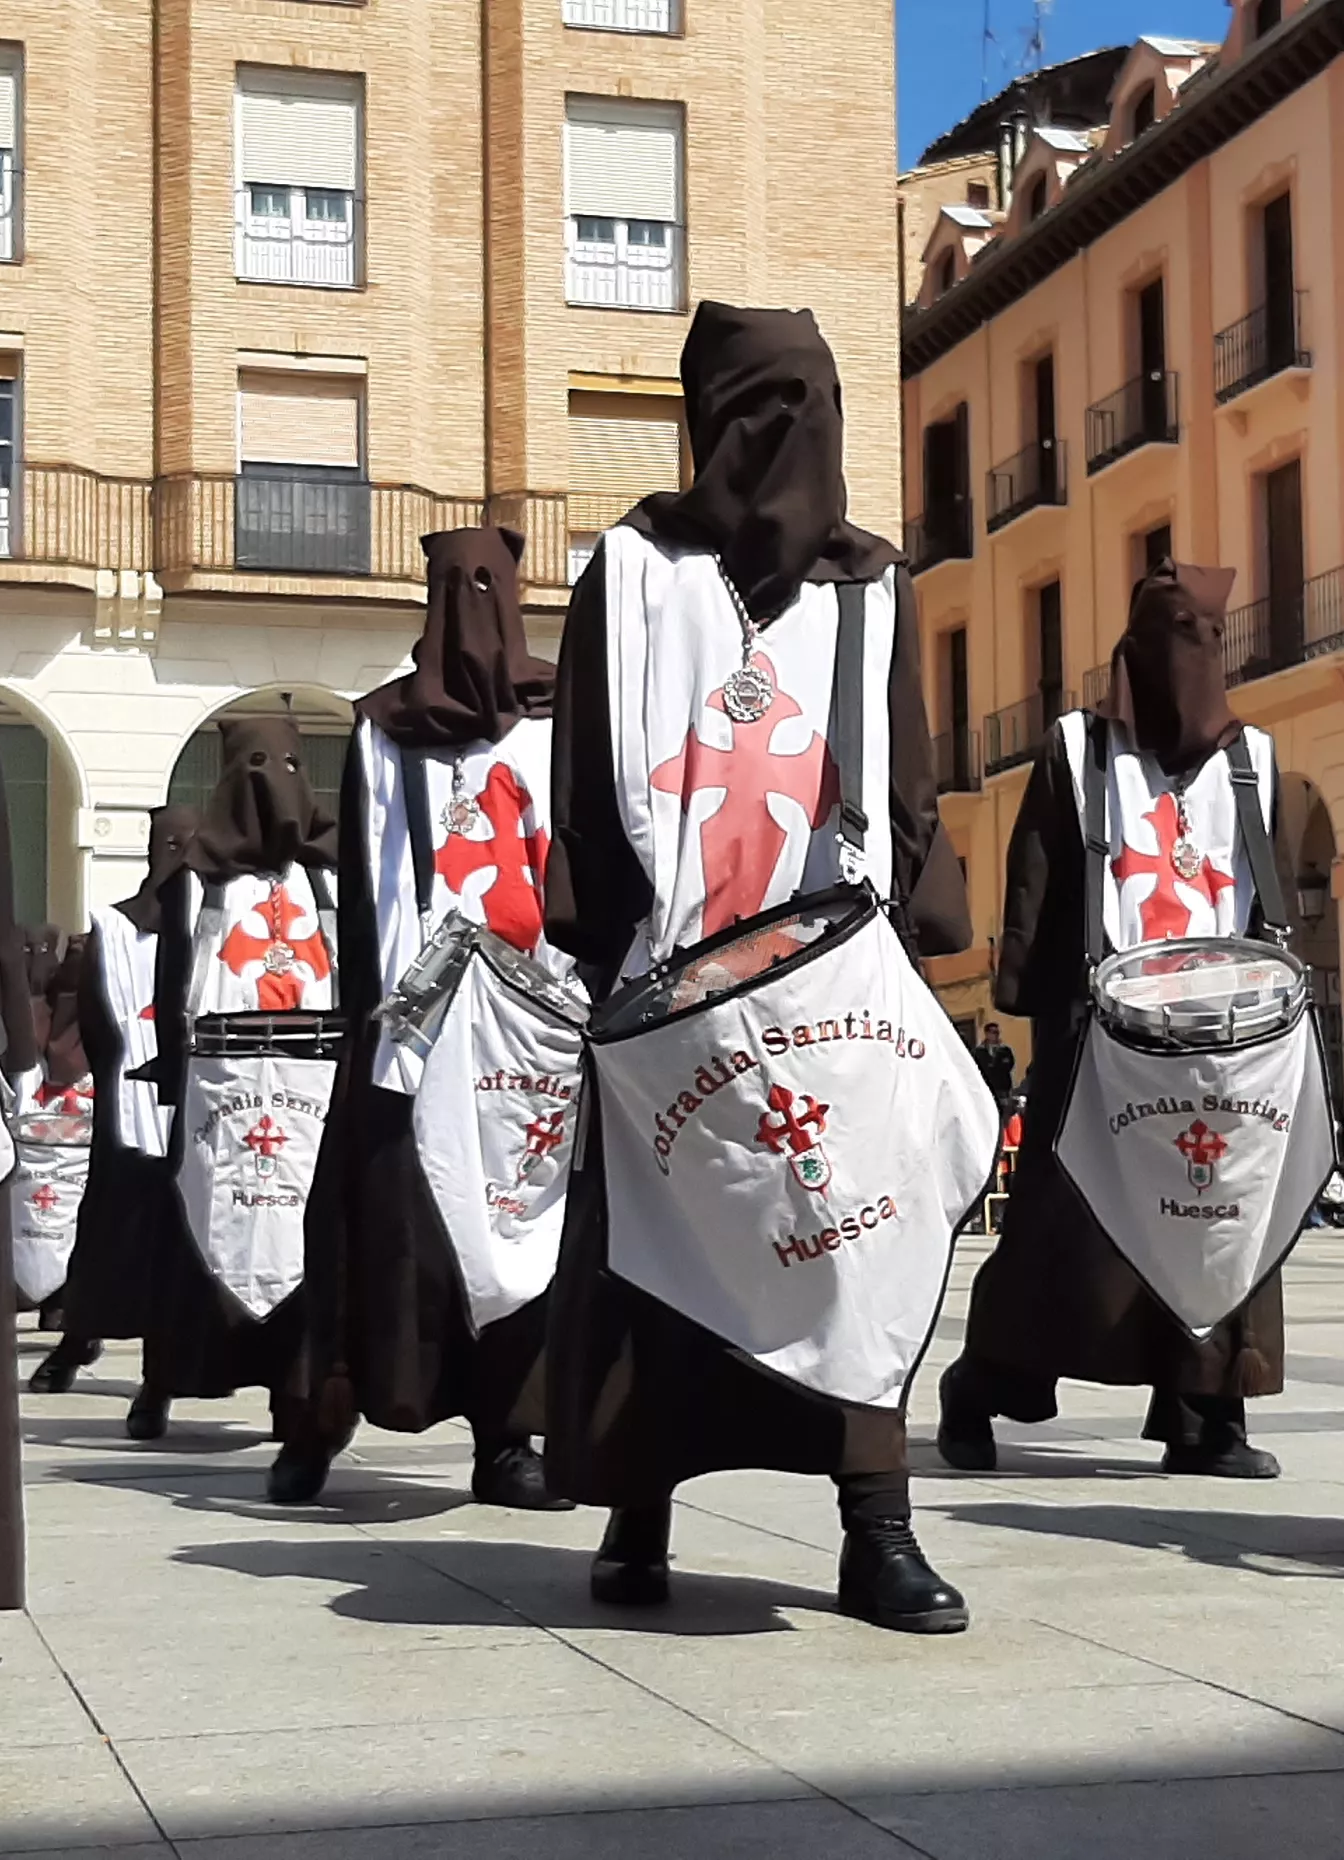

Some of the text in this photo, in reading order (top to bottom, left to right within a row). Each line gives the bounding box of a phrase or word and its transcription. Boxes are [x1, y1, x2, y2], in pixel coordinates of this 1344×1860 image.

[473, 1069, 572, 1100] ofradia
[271, 1093, 324, 1119] Sant
[652, 1048, 758, 1177] Cofradia
[232, 1189, 299, 1207] Huesca
[1159, 1197, 1240, 1220] Huesca
[771, 1193, 898, 1268] Huesca
